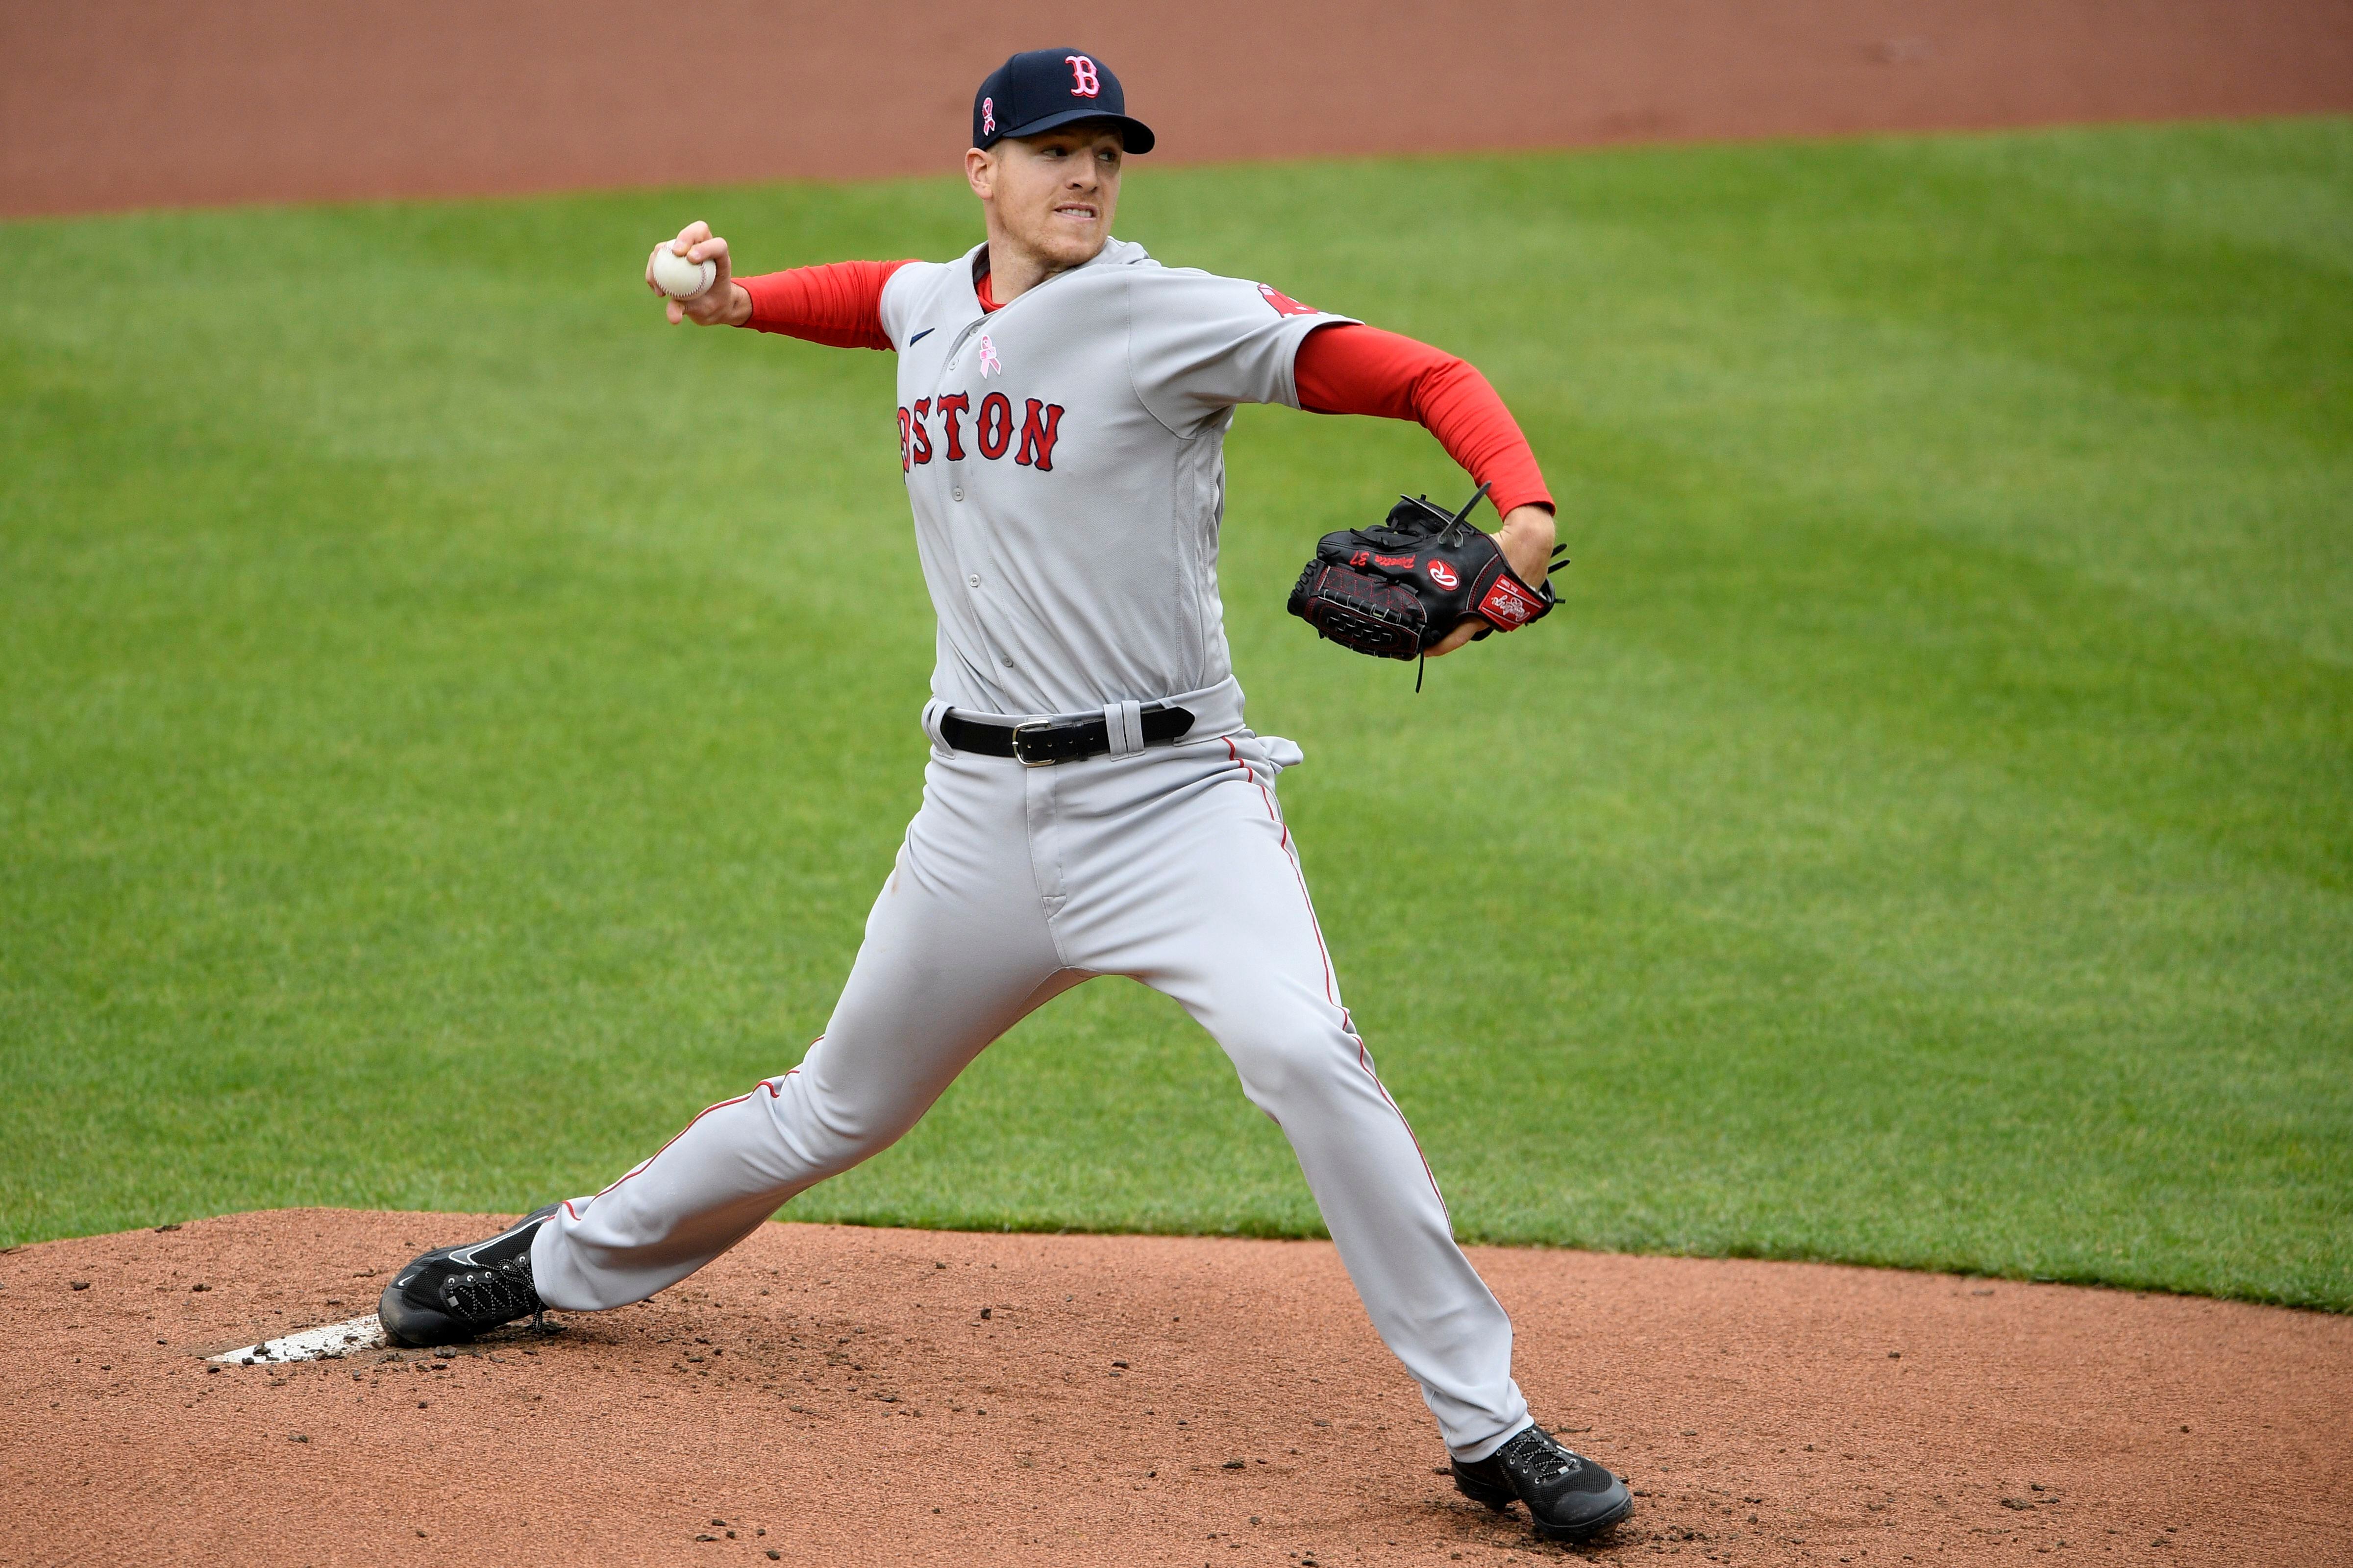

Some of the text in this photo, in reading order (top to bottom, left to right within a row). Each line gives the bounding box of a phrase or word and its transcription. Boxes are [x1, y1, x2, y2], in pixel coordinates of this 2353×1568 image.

[1065, 56, 1101, 98] B
[897, 391, 1065, 473] OSTON
[1350, 550, 1370, 566] 37
